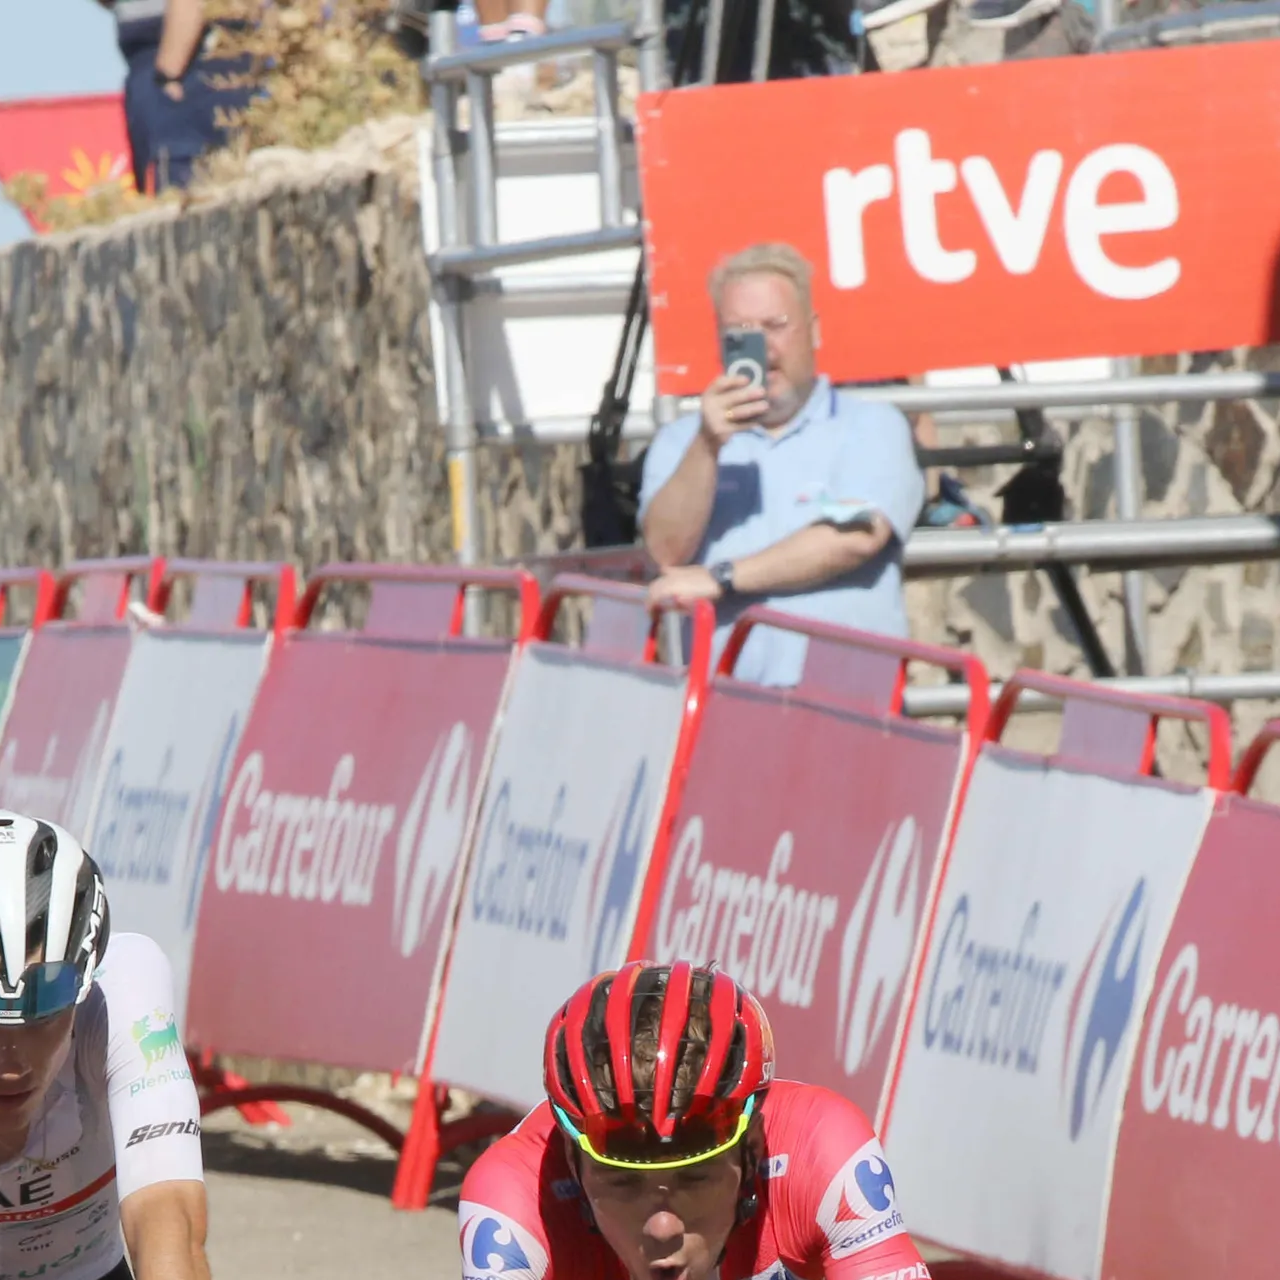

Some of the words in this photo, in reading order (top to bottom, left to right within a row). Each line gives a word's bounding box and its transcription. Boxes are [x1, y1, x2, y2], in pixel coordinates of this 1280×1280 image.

[823, 128, 1181, 300] rtve
[214, 752, 398, 907] Carrefour
[472, 778, 589, 942] Carrefour
[656, 815, 838, 1009] Carrefour
[923, 893, 1068, 1074] Carrefour
